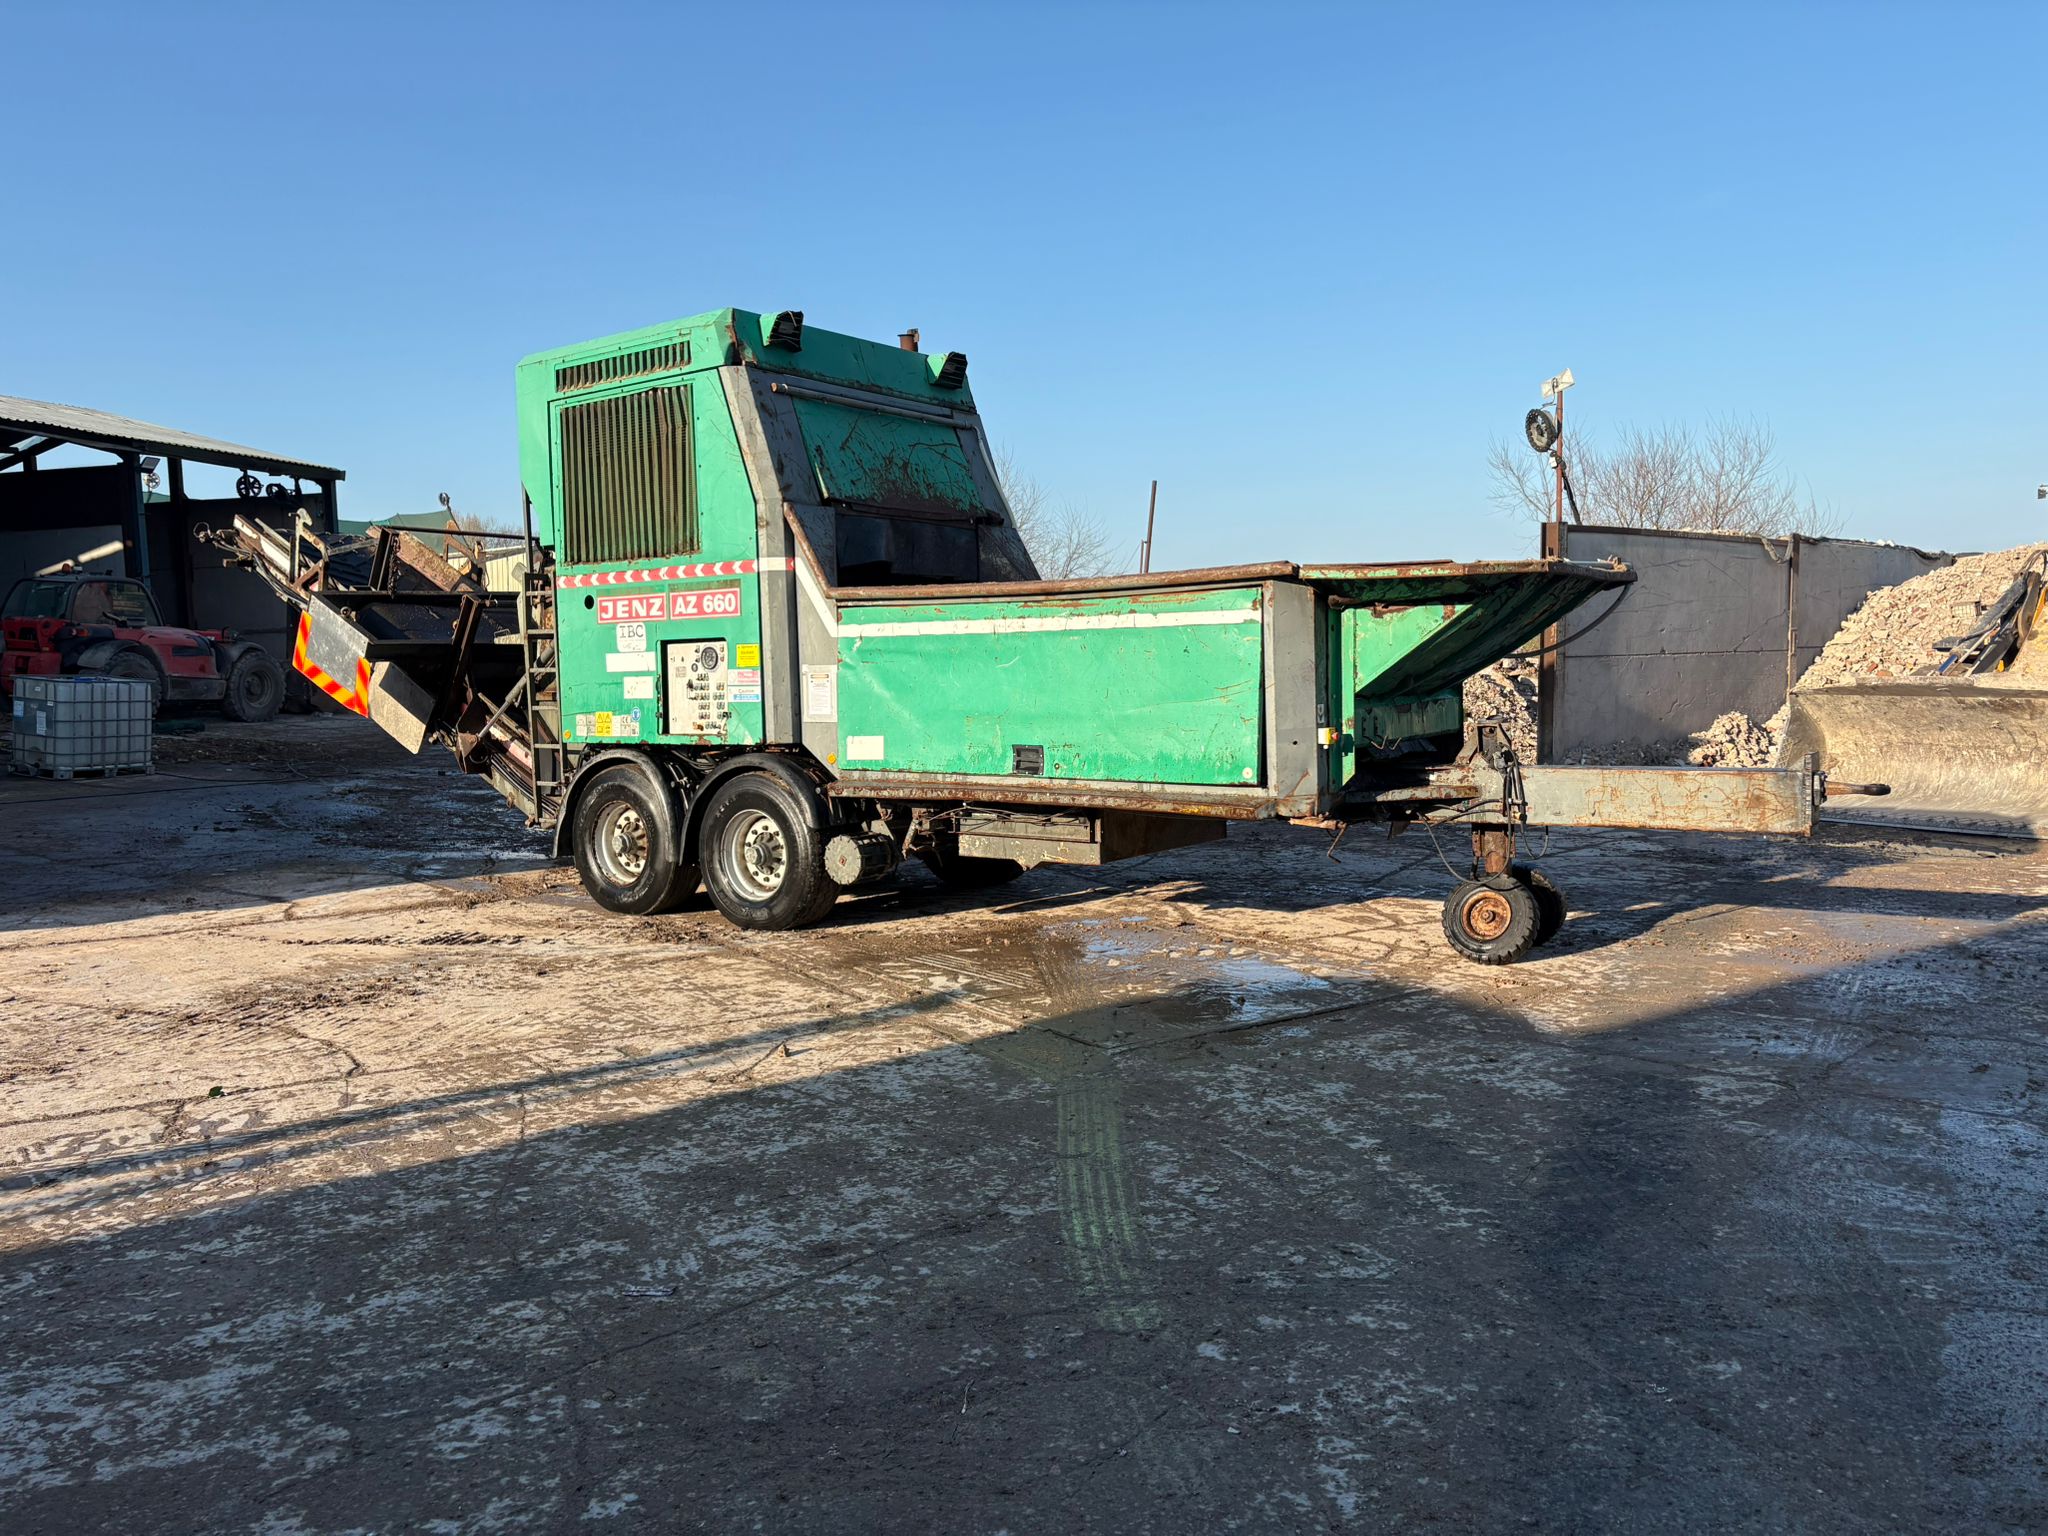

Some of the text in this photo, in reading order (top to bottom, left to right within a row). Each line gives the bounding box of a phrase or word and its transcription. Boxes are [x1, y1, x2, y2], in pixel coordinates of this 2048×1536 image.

[601, 597, 663, 619] JENZ
[674, 593, 737, 615] AZ 660
[619, 624, 645, 638] IBC
